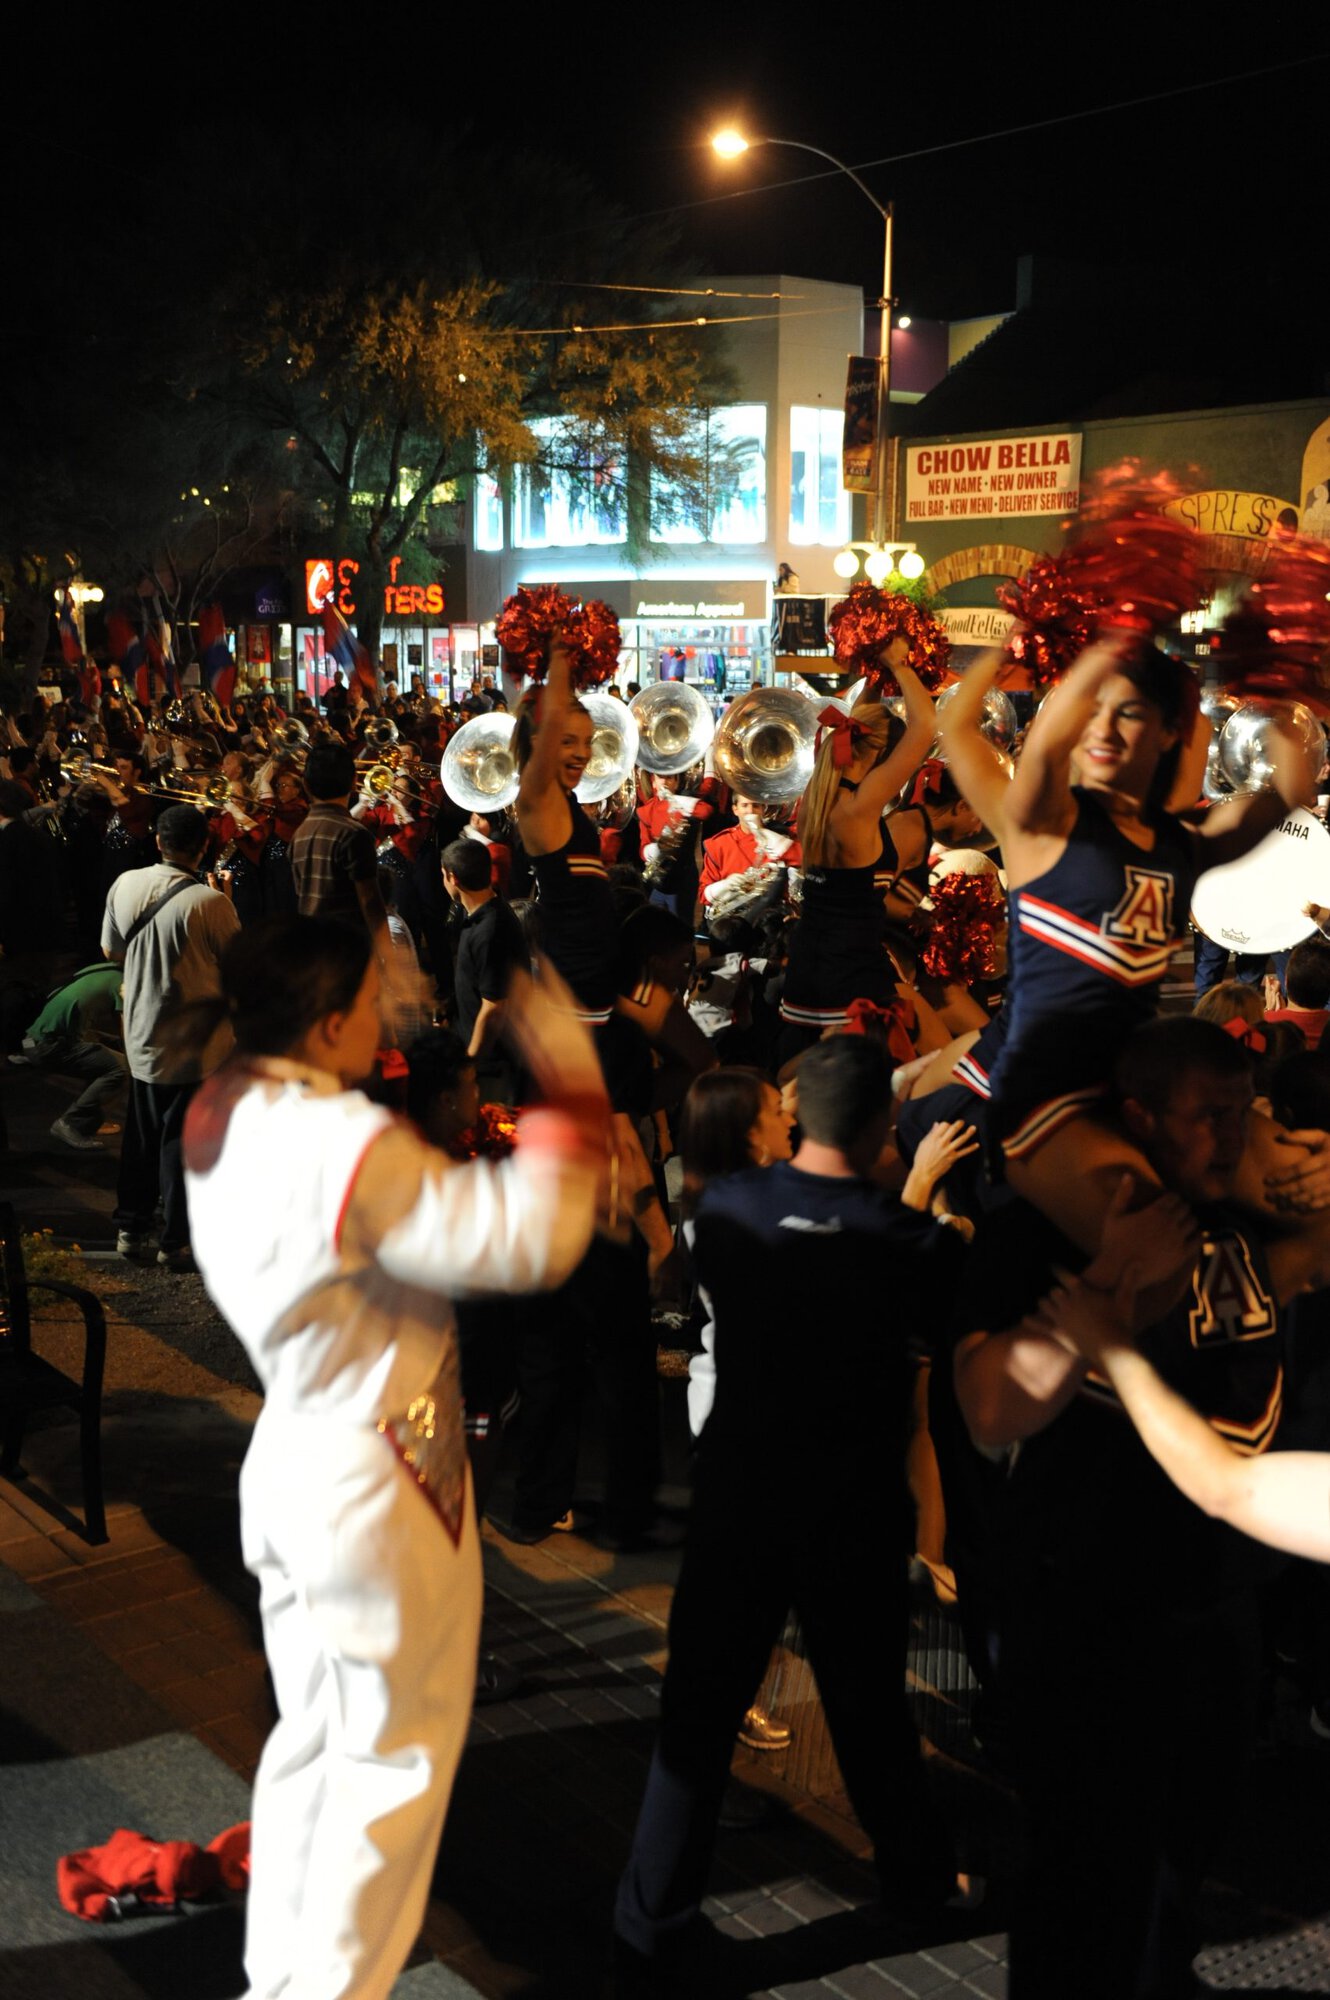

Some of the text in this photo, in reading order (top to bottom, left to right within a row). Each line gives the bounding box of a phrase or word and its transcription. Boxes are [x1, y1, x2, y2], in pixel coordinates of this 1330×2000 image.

[917, 440, 1070, 476] CHOW BELLA
[928, 471, 1057, 496] NEW NAME NEW OWNER
[909, 491, 1078, 518] FULL BAR NEW MENU DELIVERY SERVICE
[1101, 865, 1174, 947] A
[1189, 1229, 1276, 1348] A
